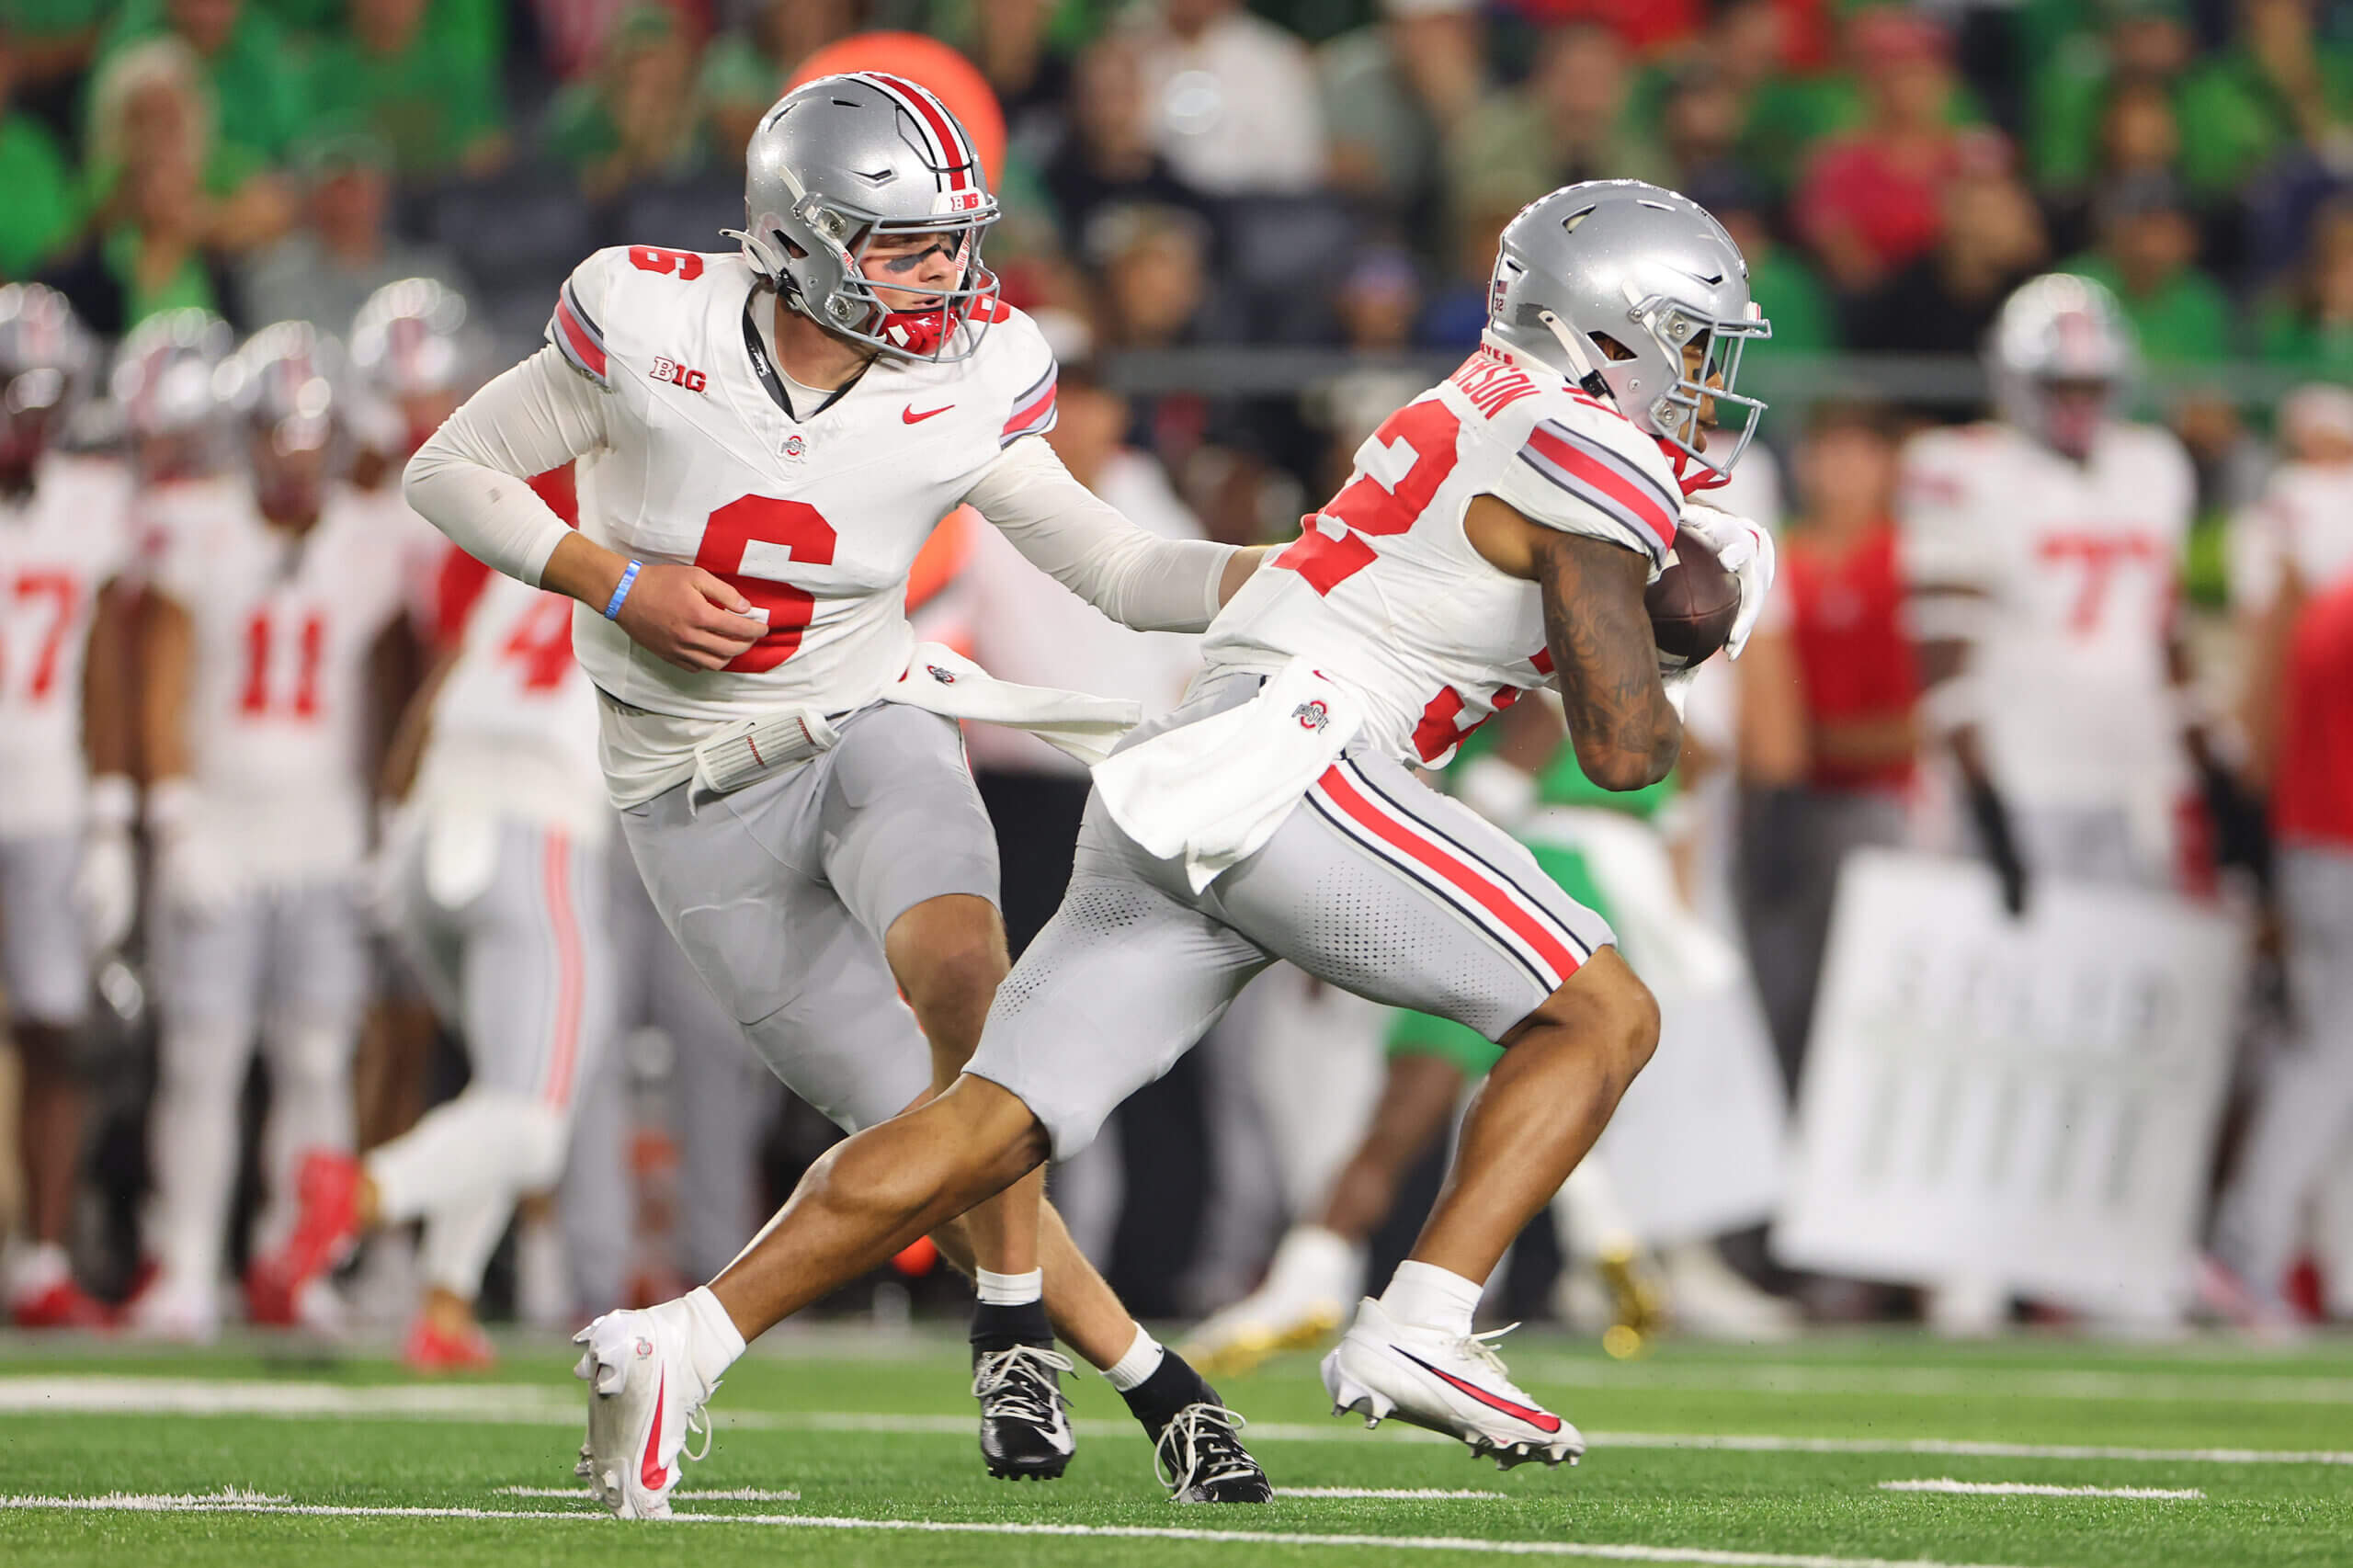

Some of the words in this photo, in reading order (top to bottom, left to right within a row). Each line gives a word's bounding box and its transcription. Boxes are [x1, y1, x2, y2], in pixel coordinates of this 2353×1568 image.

[629, 244, 704, 281] 6
[0, 572, 78, 703] 7
[694, 494, 837, 674] 6
[237, 609, 324, 722] 11
